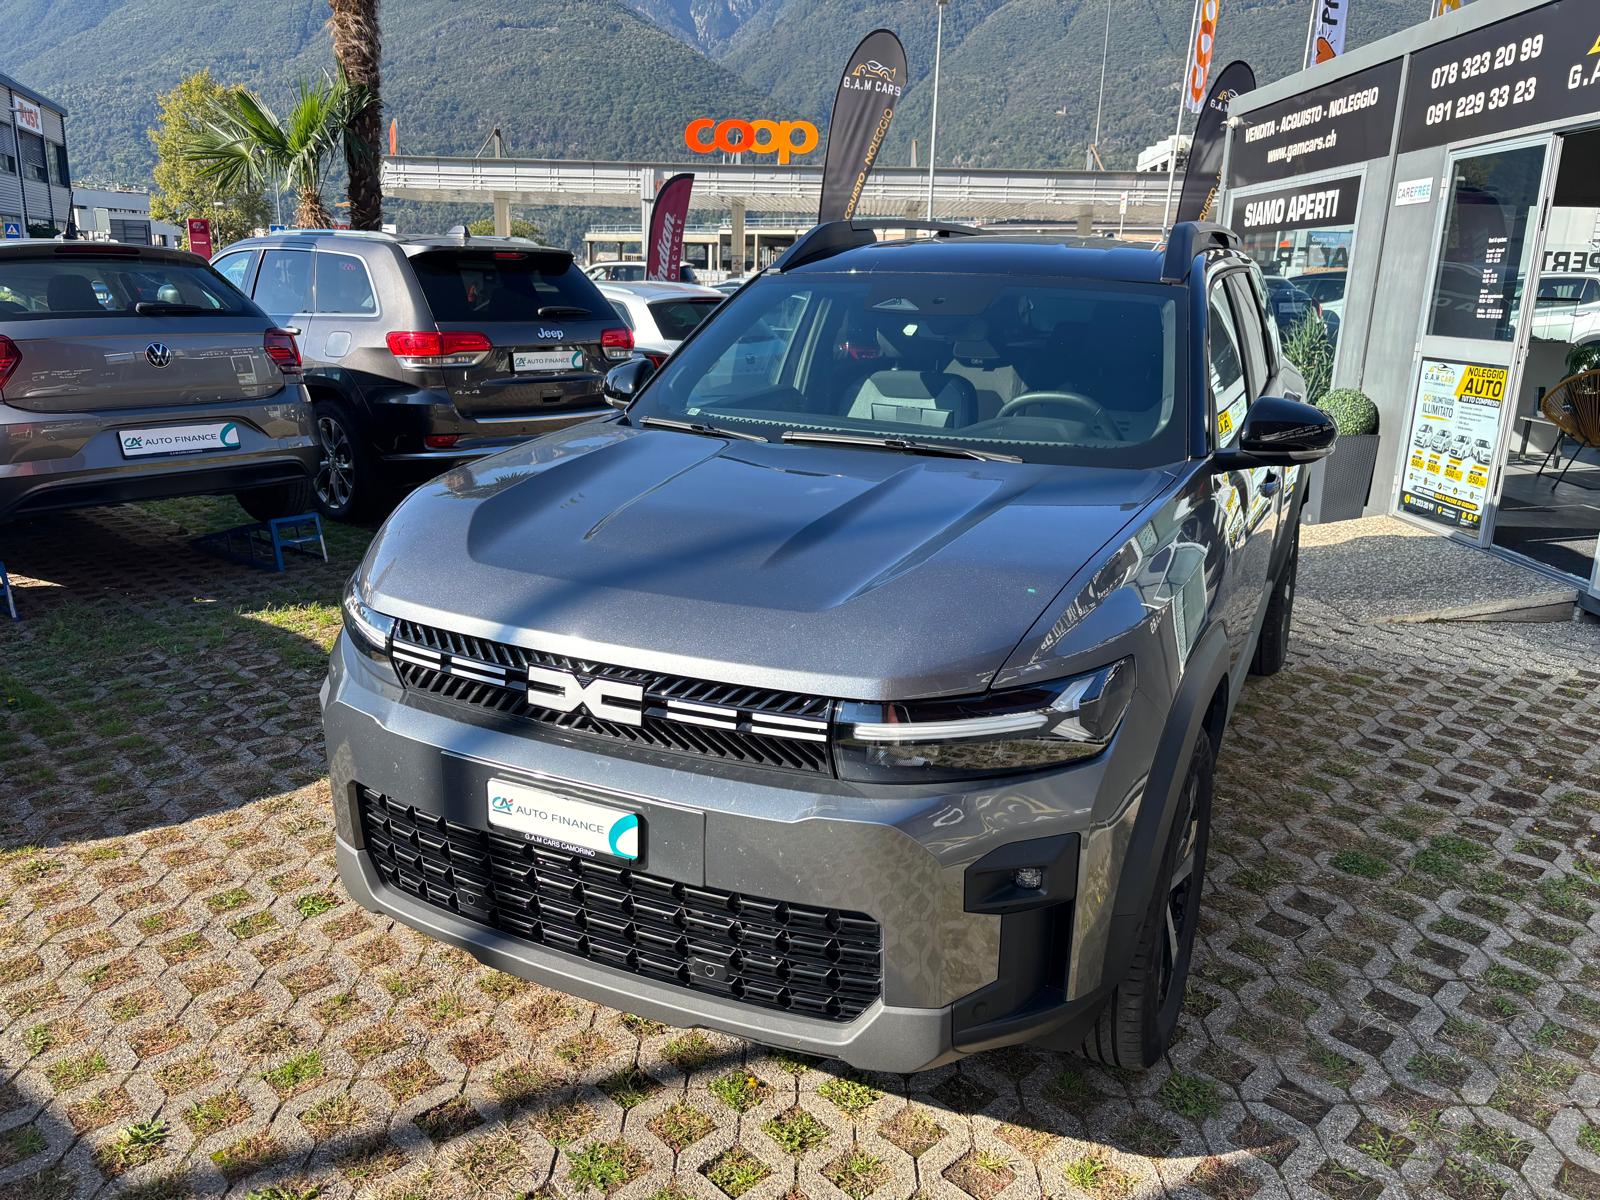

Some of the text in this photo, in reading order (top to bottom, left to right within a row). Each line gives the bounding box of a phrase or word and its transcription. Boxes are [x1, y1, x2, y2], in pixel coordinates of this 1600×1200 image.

[1191, 0, 1219, 104] coo
[1431, 34, 1543, 89] 078 323 20 99
[843, 76, 901, 96] G.A.M CARS
[1426, 77, 1537, 125] 091 229 33 23
[1245, 120, 1276, 143] VENDITA
[1280, 105, 1322, 133] ACQUISTO
[1329, 86, 1379, 118] NOLEGGIO
[684, 118, 819, 164] coop
[1267, 129, 1337, 163] www.gamcars.ch
[844, 172, 866, 220] CQUISTO
[864, 108, 893, 166] NOLEGGIO
[1200, 187, 1217, 221] QUISTO
[1397, 184, 1431, 199] CAREFREE
[1244, 189, 1340, 227] SIAMO APERTI
[670, 219, 682, 280] ORCYCLE
[537, 327, 564, 340] Jeep
[1463, 378, 1503, 397] AUTO
[1467, 367, 1504, 380] NOLEGGIO
[1422, 404, 1454, 418] ILLIMITATO
[145, 437, 173, 445] AUTO
[175, 433, 217, 443] FINANCE
[1468, 474, 1480, 485] 550
[516, 805, 548, 820] AUTO
[551, 814, 605, 834] FINANCE
[543, 838, 560, 848] CARS
[561, 842, 596, 857] CAMORINO
